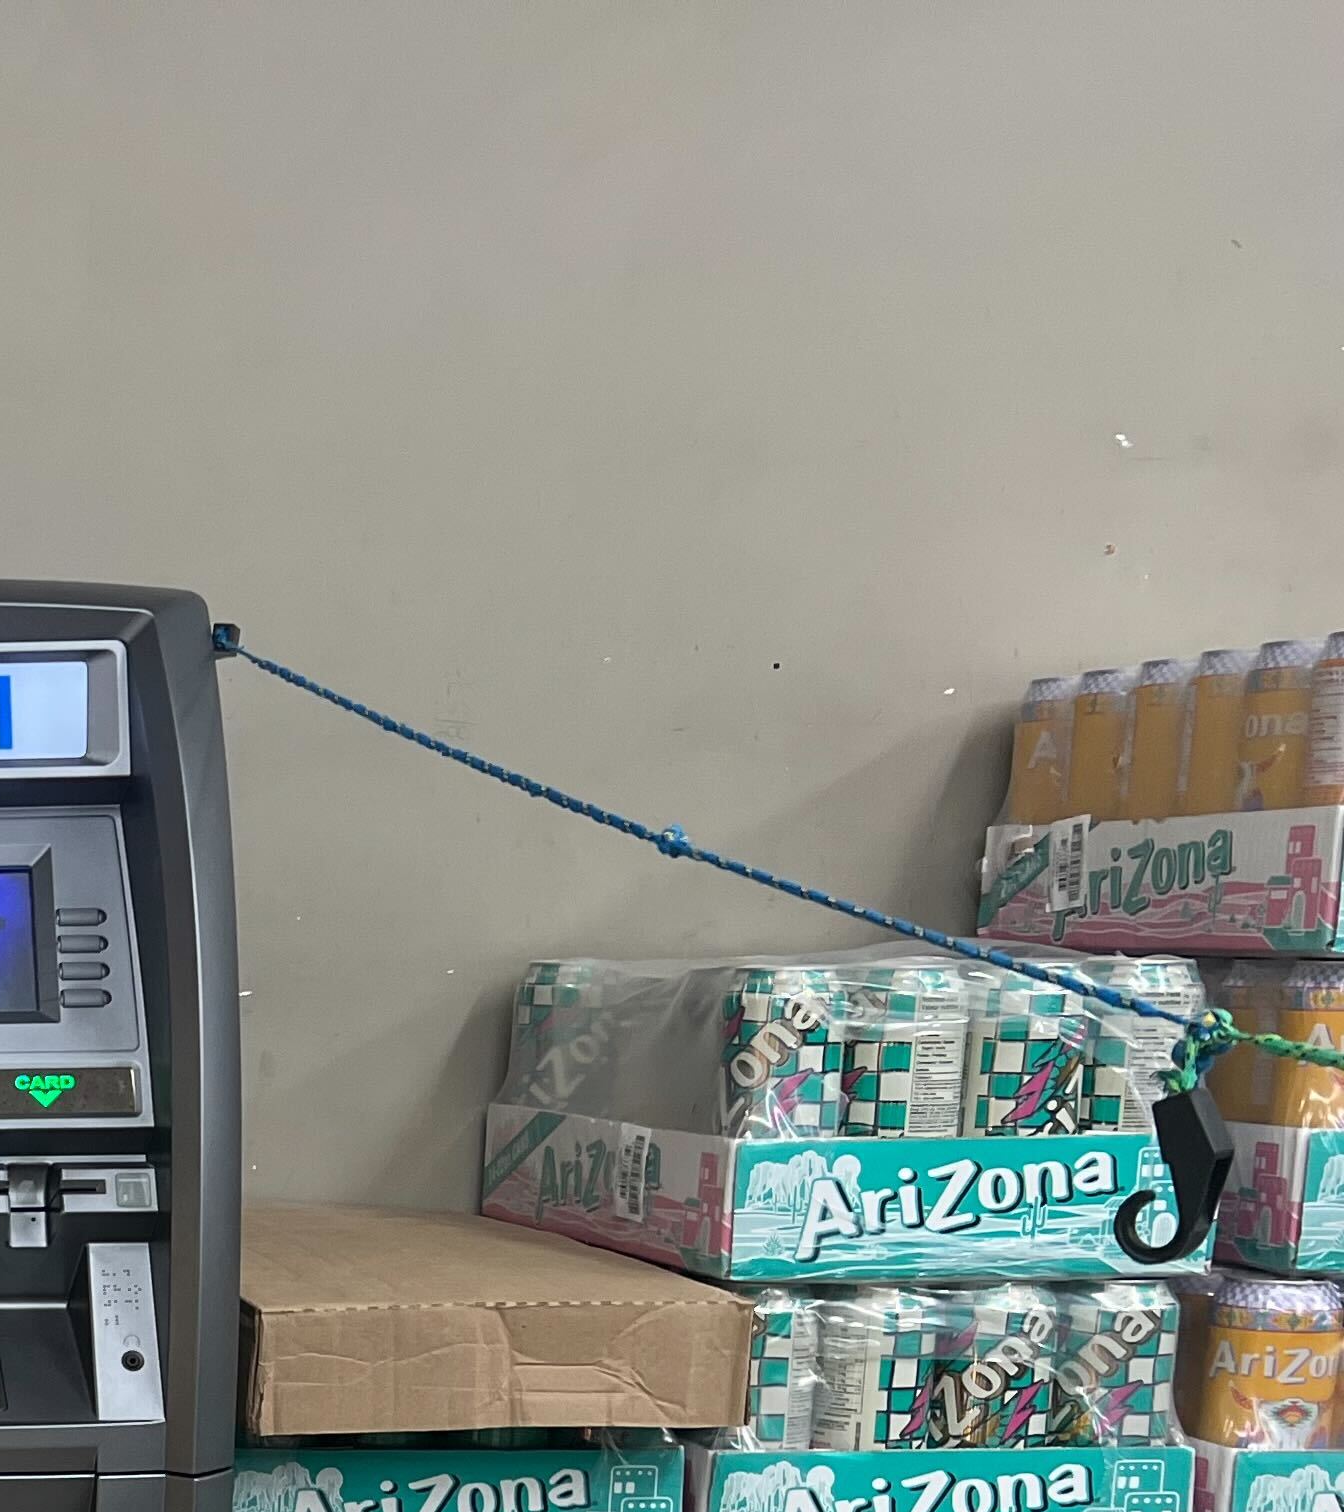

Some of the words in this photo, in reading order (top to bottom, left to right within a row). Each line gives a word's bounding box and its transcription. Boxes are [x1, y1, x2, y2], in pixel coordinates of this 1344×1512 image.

[1051, 829, 1233, 944] riZona
[14, 1074, 76, 1091] CARD
[795, 1149, 1120, 1263] AriZona
